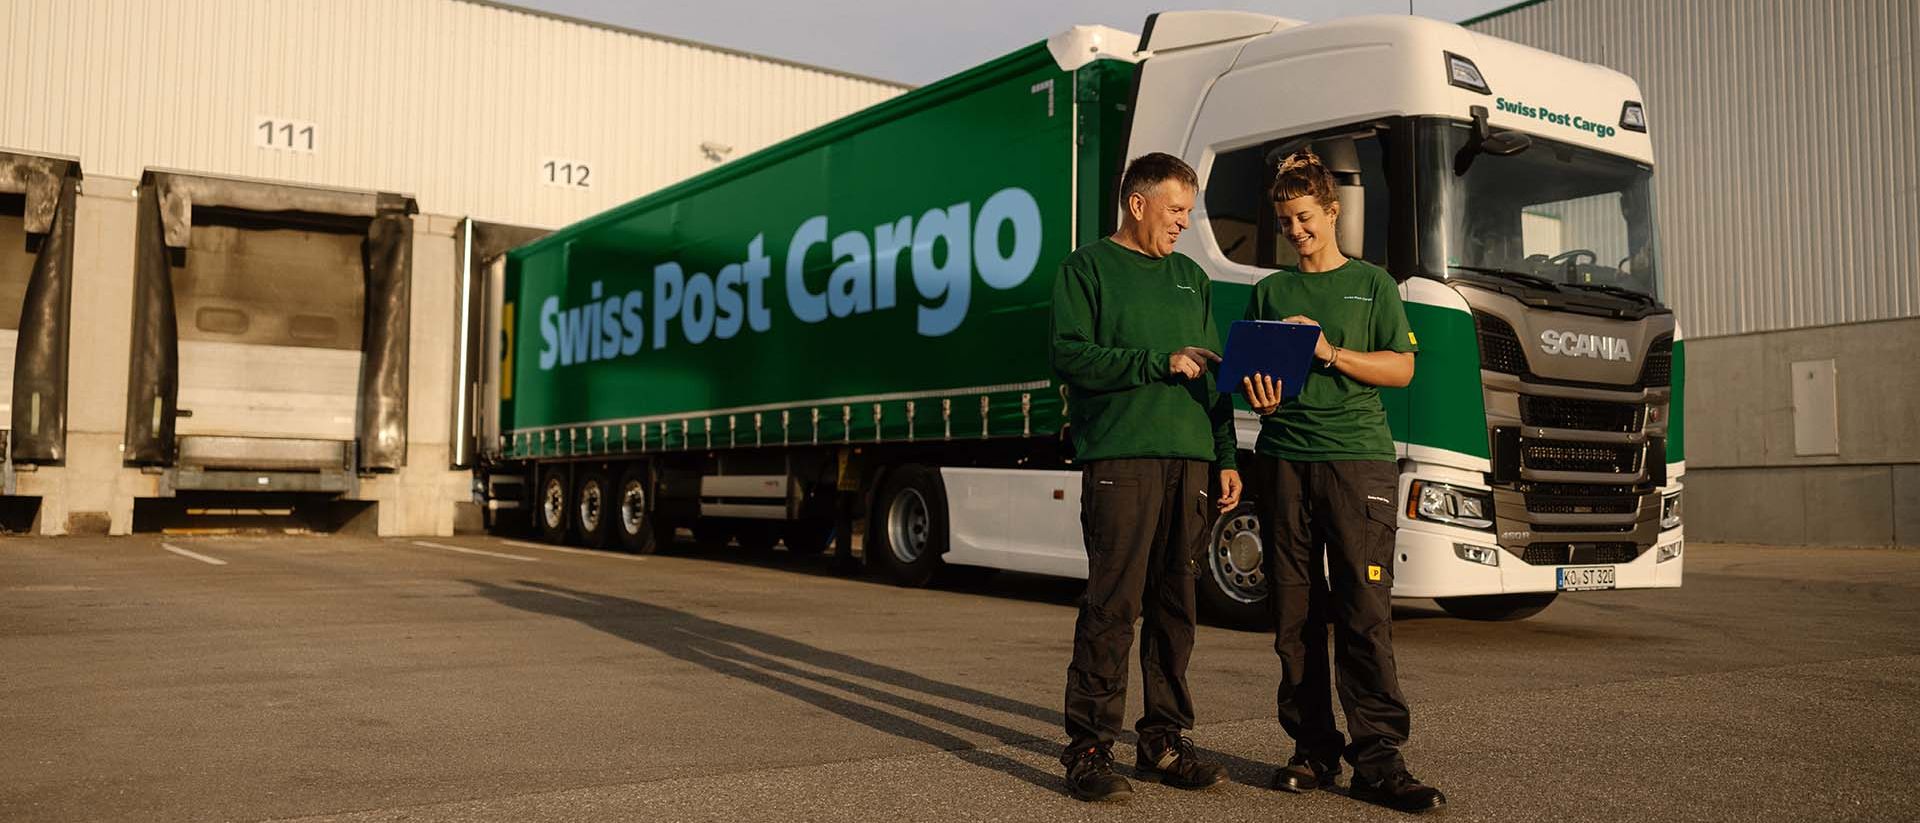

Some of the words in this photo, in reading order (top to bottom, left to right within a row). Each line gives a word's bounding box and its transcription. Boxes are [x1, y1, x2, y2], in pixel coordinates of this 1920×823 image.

[1496, 97, 1536, 118] Swiss
[1539, 107, 1571, 126] Post
[1573, 116, 1616, 138] Cargo
[258, 120, 314, 149] 111
[543, 161, 591, 187] 112
[539, 280, 644, 371] Swiss
[652, 231, 771, 350] Post
[785, 186, 1043, 337] Cargo
[1541, 329, 1632, 362] SCANIA
[1583, 569, 1595, 584] ST
